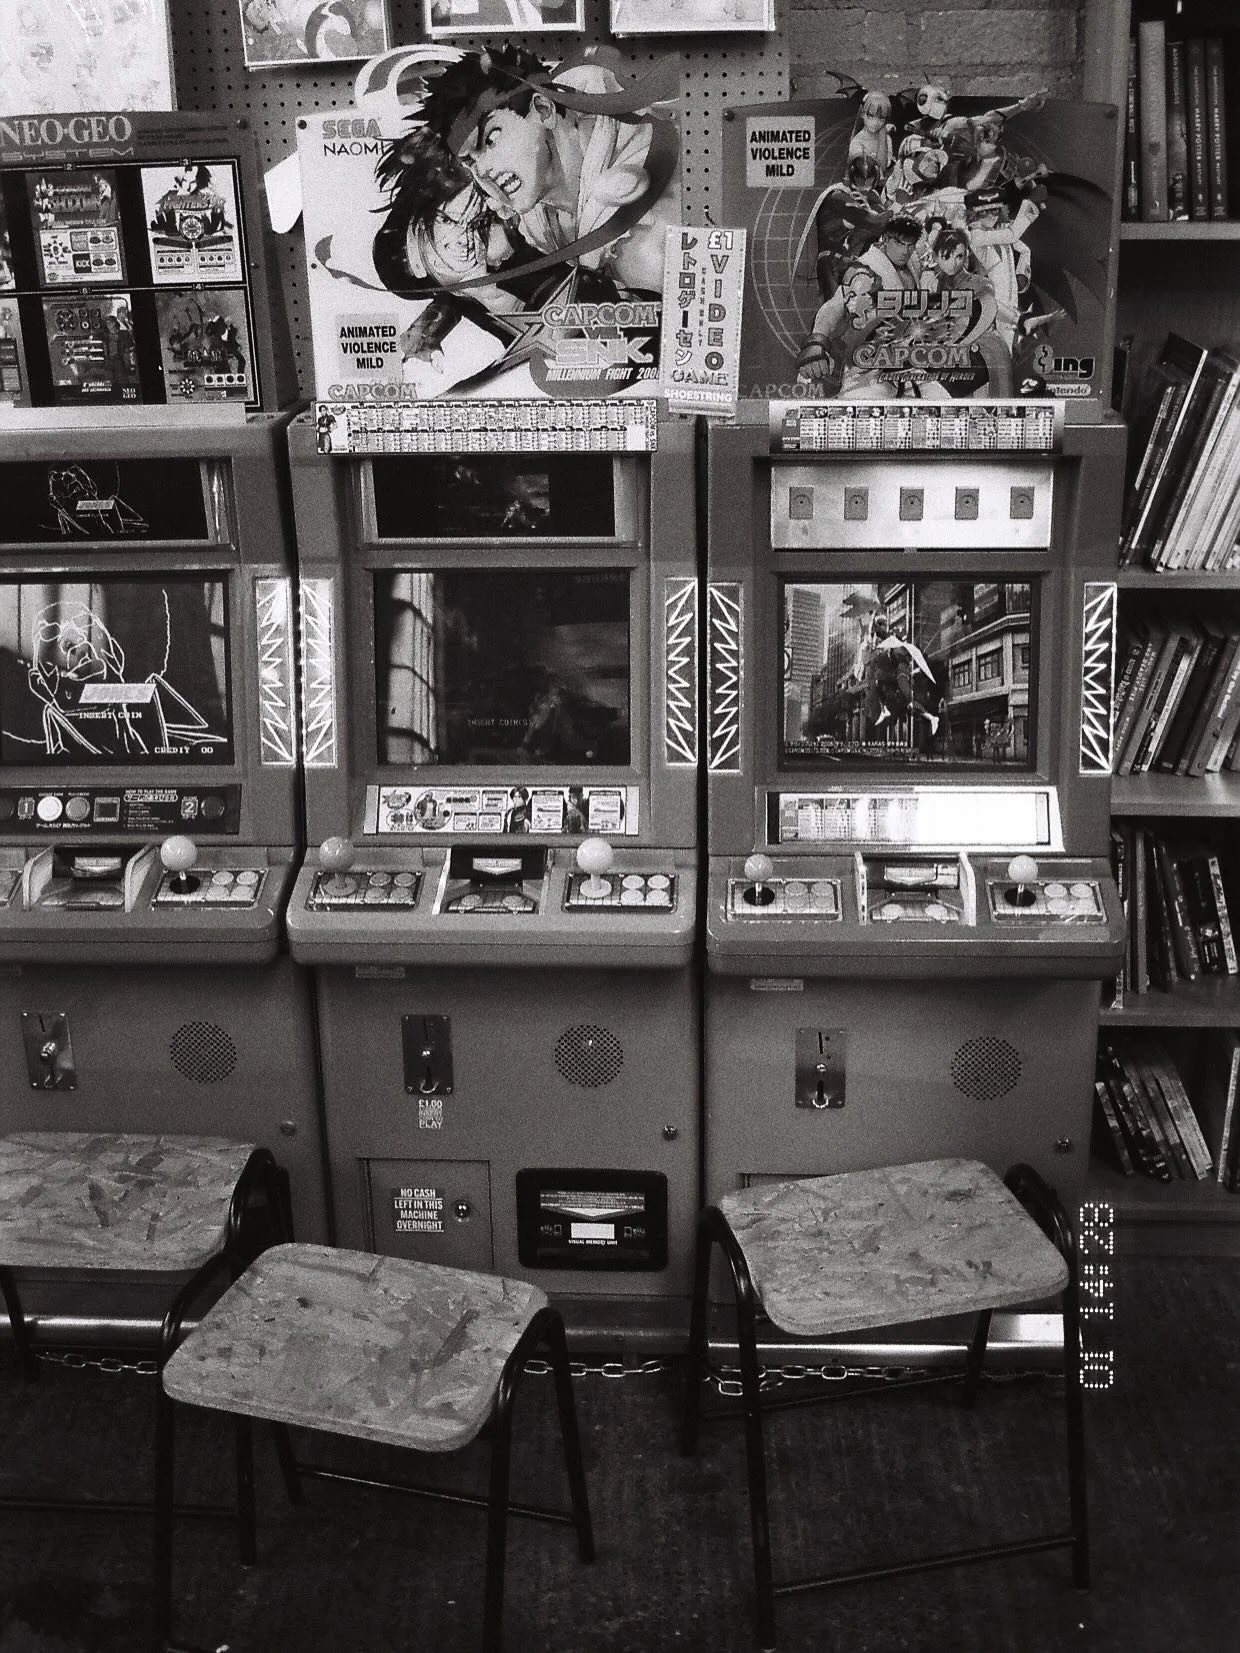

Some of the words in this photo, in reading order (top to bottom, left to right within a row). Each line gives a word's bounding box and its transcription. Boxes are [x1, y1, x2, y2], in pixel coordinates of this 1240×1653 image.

[322, 118, 381, 139] SEGA
[750, 130, 811, 143] ANIMATED
[751, 147, 810, 160] VIOLENCE
[765, 164, 795, 177] MILD
[707, 230, 734, 251] £1
[542, 303, 661, 328] CAPCOM
[704, 254, 730, 371] VIDEO
[339, 325, 397, 339] ANIMATED
[341, 341, 397, 354] VIOLENCE
[852, 341, 972, 369] CAPCOM
[356, 357, 384, 369] MILD
[605, 367, 634, 380] FIGHT
[327, 382, 418, 400] CAPCOM
[79, 711, 114, 719] INSERT
[118, 711, 143, 719] COIN
[154, 746, 190, 754] CREDIT
[184, 801, 195, 813] 2
[420, 1119, 443, 1129] PLAY
[400, 1188, 413, 1198] NO
[414, 1188, 436, 1198] CASH
[394, 1199, 413, 1209] LEFT
[413, 1200, 424, 1209] IN
[424, 1200, 443, 1210] THIS
[400, 1209, 438, 1220] MACHINE
[396, 1219, 443, 1230] OVERNIGHT
